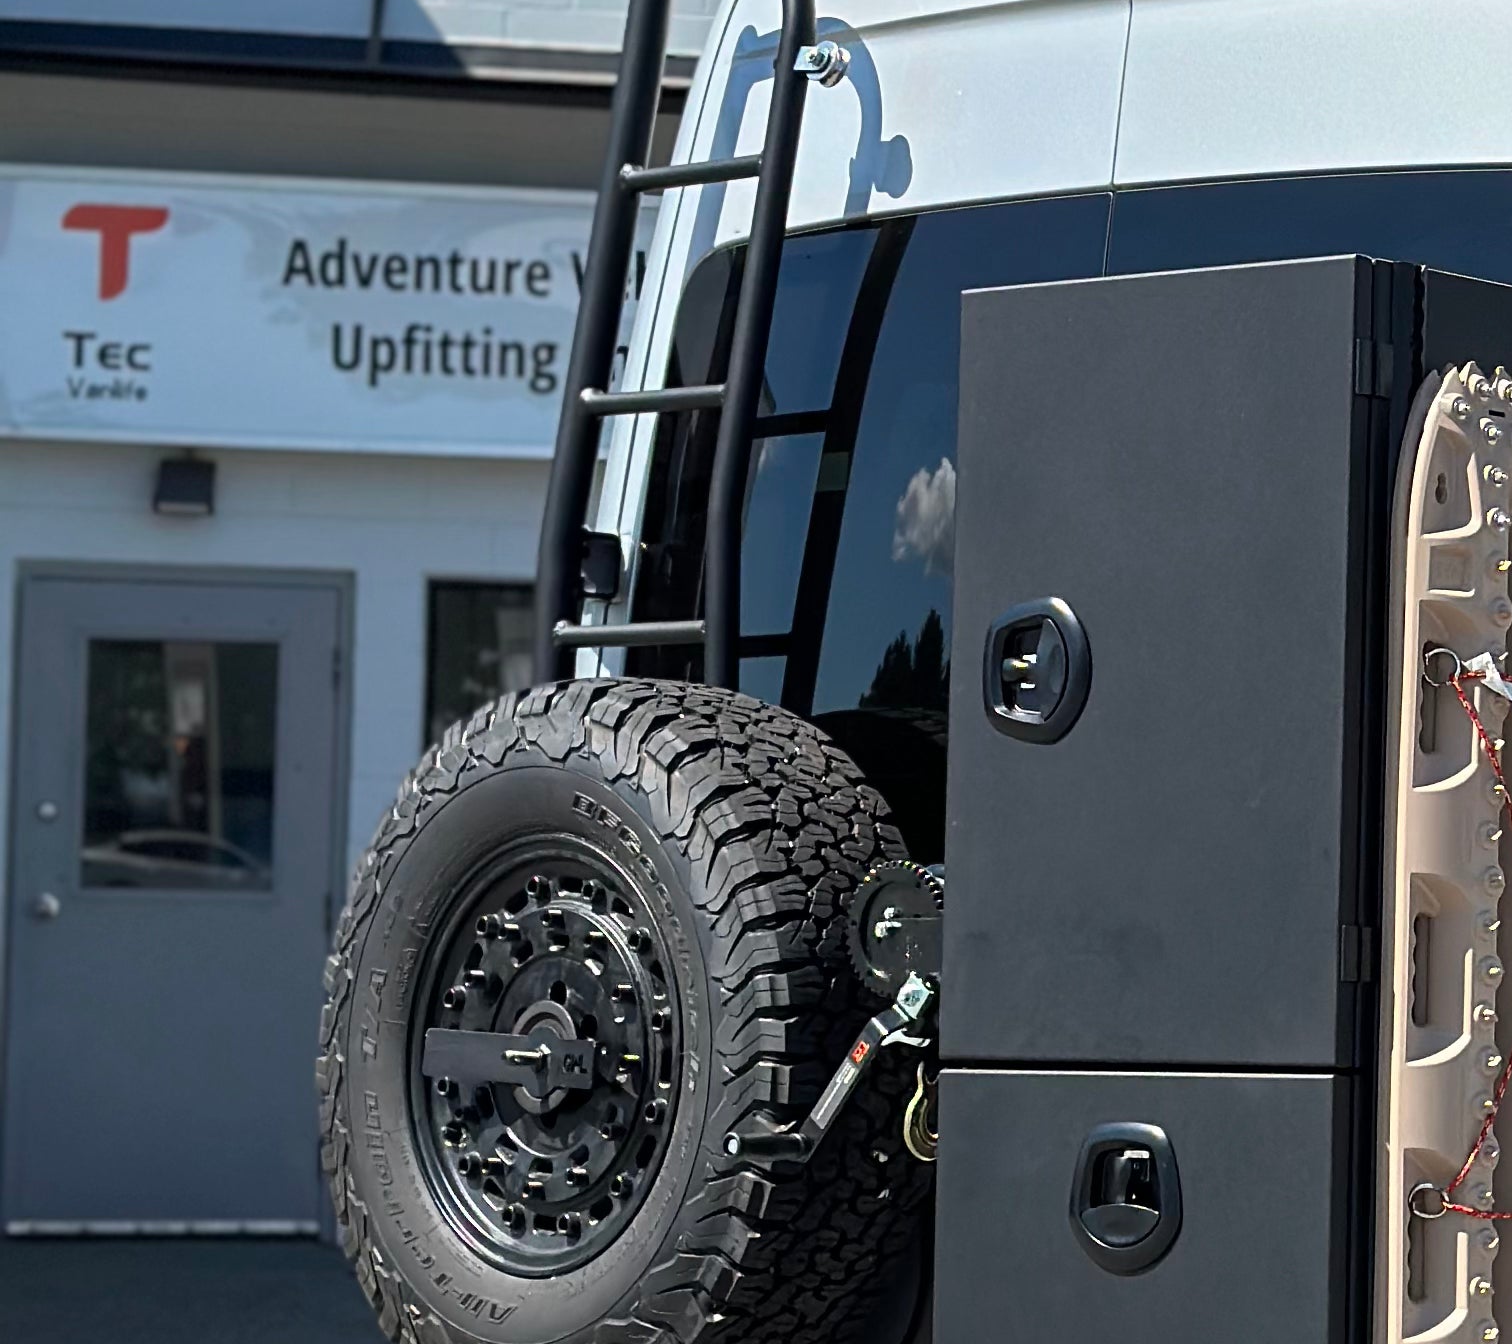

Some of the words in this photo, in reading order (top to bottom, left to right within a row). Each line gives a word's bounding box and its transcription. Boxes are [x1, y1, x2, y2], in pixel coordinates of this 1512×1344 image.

[61, 202, 170, 301] T
[282, 237, 551, 297] Adventure
[330, 321, 558, 395] Upfitting
